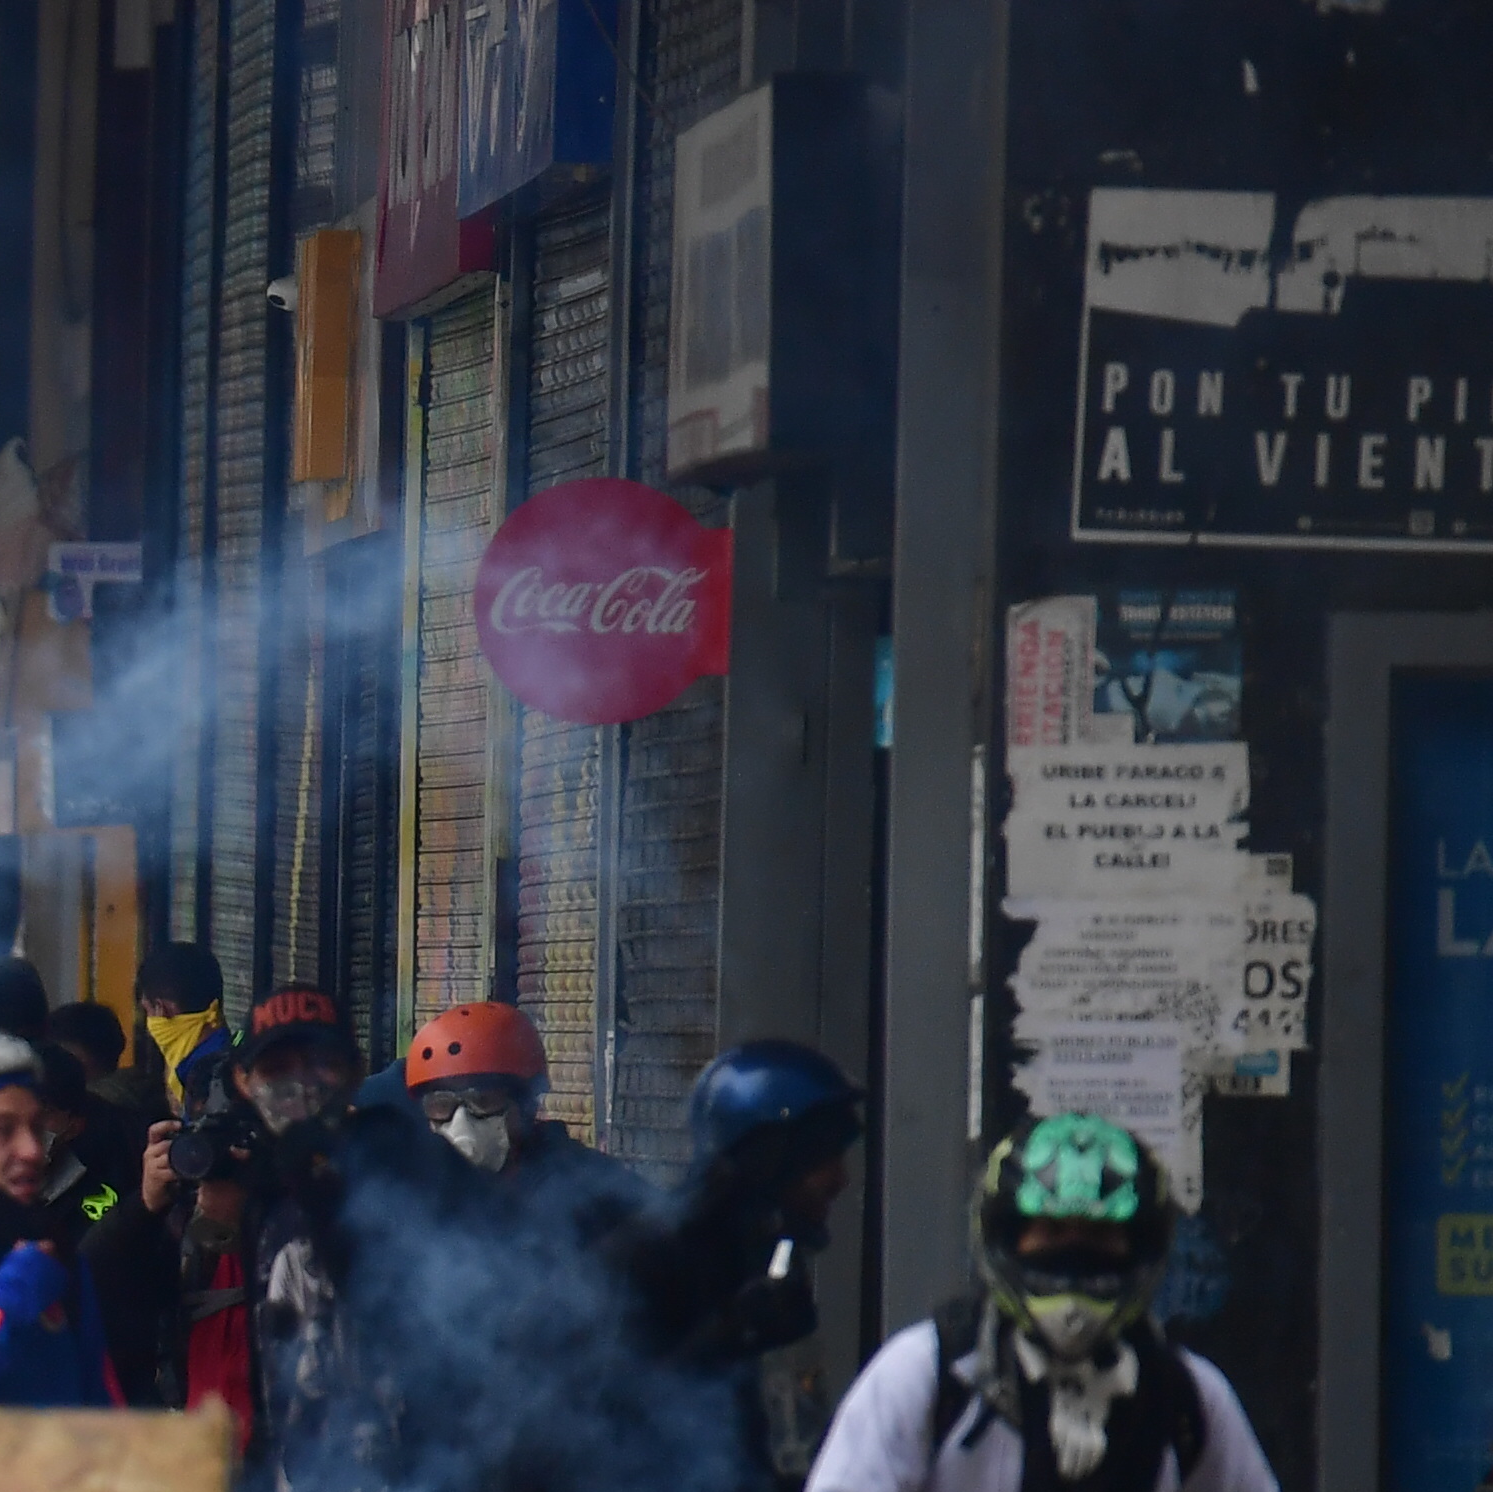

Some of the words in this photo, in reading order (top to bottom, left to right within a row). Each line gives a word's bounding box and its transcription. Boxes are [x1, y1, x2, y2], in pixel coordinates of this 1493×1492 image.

[1100, 362, 1225, 417] PON
[1280, 373, 1351, 421] TU
[1407, 376, 1493, 424] PI
[1098, 427, 1185, 484] AL
[1042, 765, 1107, 781] URIBE
[1116, 764, 1205, 781] PARACO
[1070, 793, 1096, 808] LA
[1045, 824, 1067, 840] EL
[1172, 824, 1186, 840] A
[1193, 824, 1220, 840] LA
[1437, 837, 1493, 879] LA
[1436, 888, 1493, 958] L
